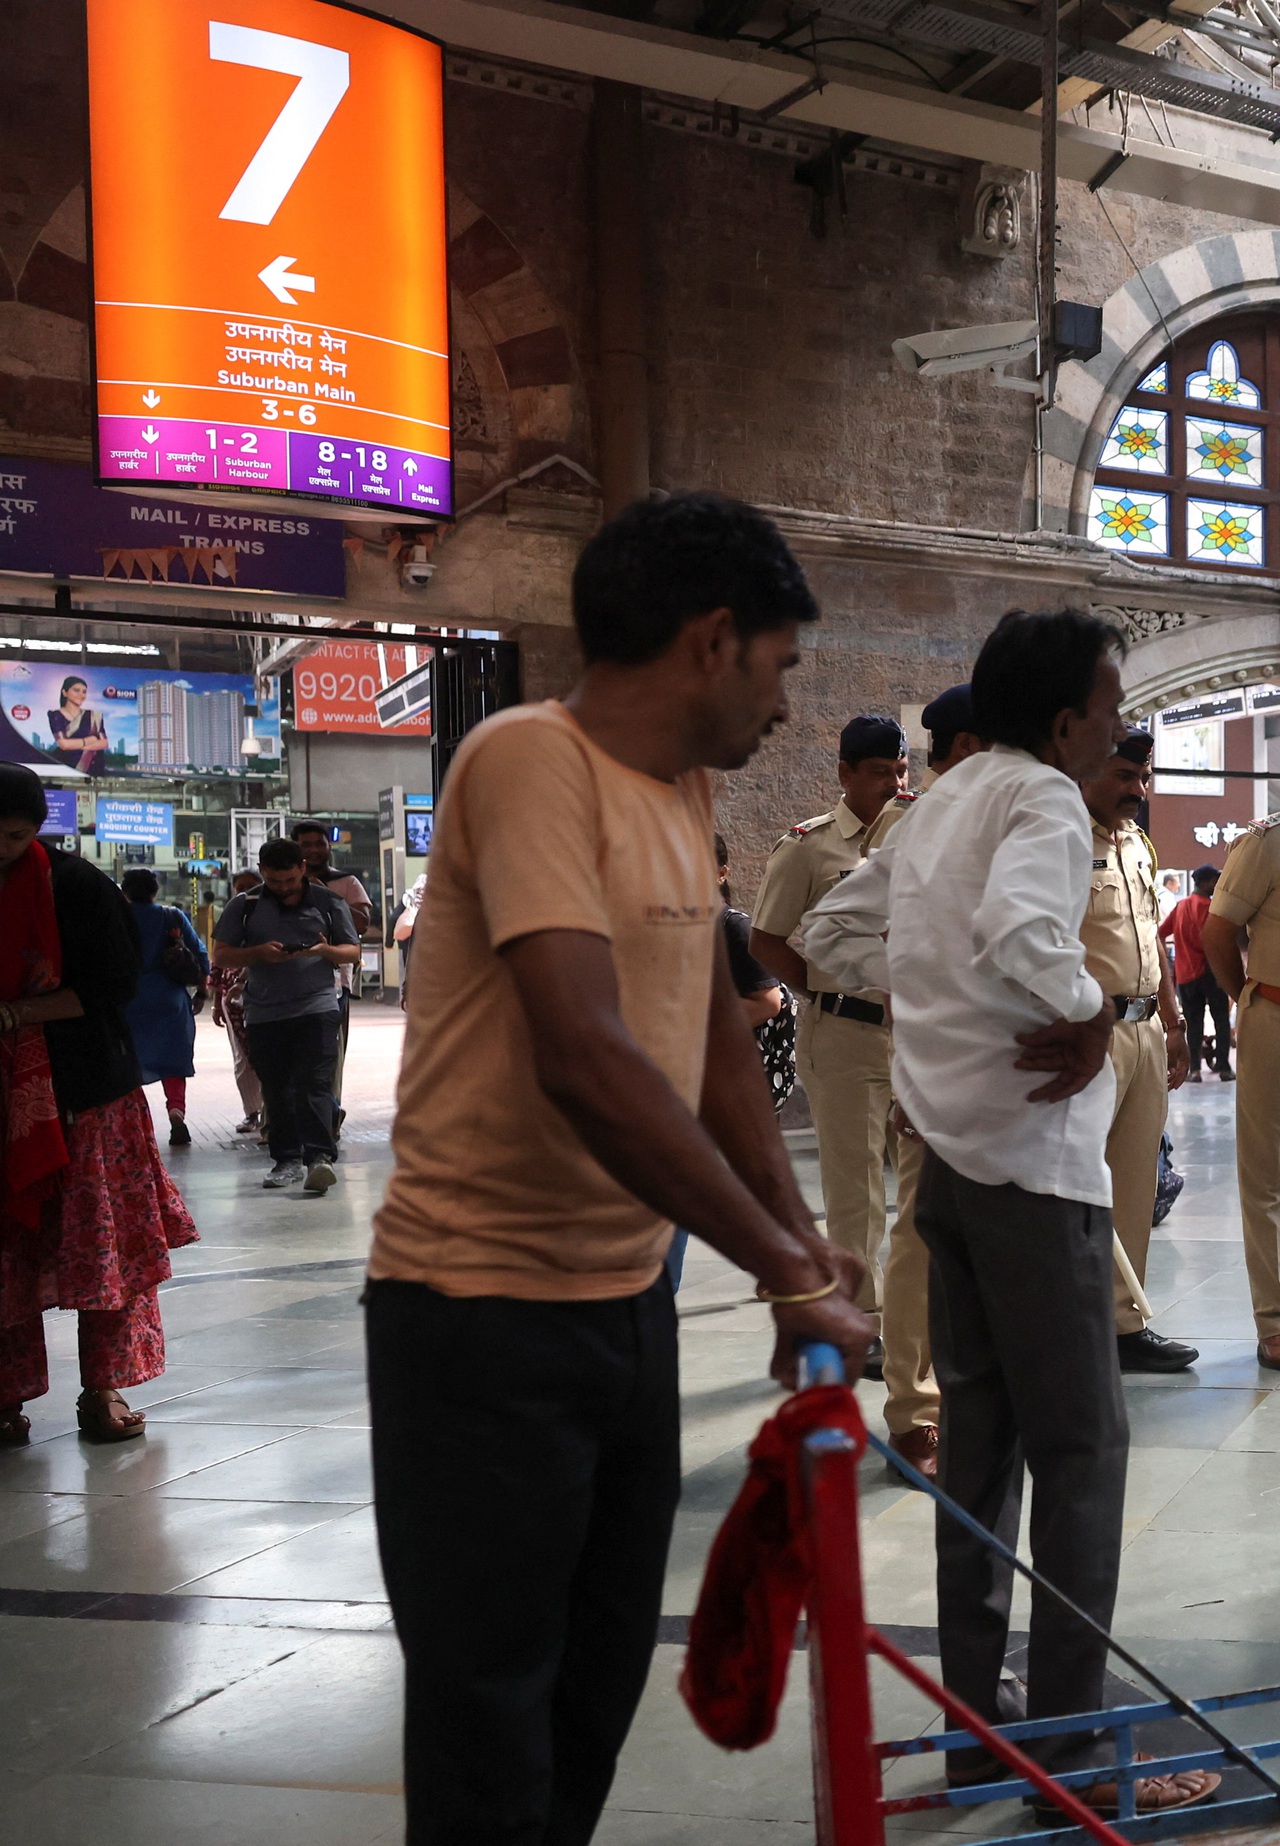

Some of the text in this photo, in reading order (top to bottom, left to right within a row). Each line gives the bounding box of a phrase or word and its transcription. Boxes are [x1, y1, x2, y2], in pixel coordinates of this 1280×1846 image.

[209, 20, 350, 226] 7
[224, 321, 347, 354] उपनगरीय मेन
[224, 346, 348, 378] उपनगरीय मेन
[217, 369, 356, 402] Suburban Main
[110, 449, 148, 460] उपनगरीय
[166, 451, 206, 463] उपनगरीय
[318, 441, 388, 471] 8-18
[225, 457, 272, 470] Suburban
[228, 468, 269, 480] Harbour
[317, 466, 331, 477] मेल
[370, 473, 383, 485] मेल
[418, 483, 434, 495] Mail
[411, 492, 440, 506] Express
[130, 506, 188, 525] MAIL
[208, 513, 310, 536] EXPRESS
